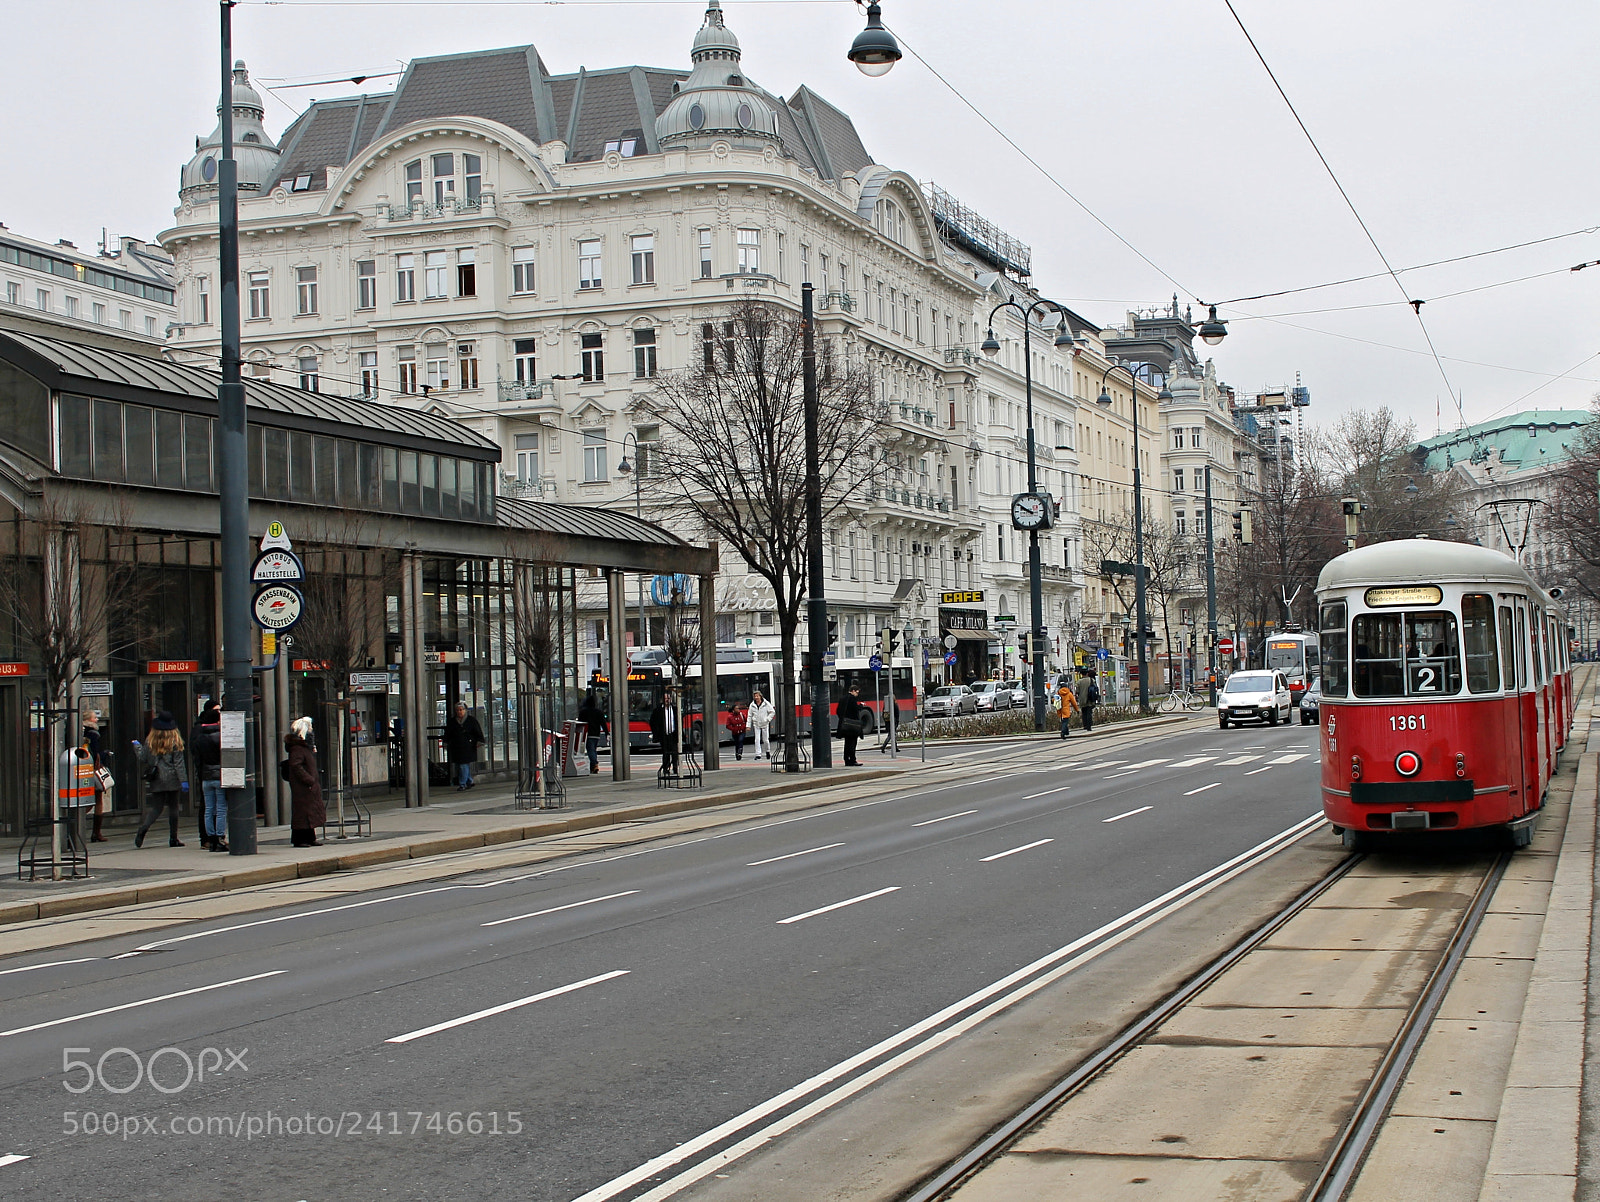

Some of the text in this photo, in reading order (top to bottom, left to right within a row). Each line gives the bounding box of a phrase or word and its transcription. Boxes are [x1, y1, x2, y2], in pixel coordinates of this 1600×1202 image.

[271, 524, 279, 535] H
[263, 553, 291, 565] AUTOBUS
[257, 570, 297, 578] HALTESTELLE
[258, 589, 297, 607] STRASSENBAHN
[943, 591, 982, 603] CAFE
[1368, 588, 1400, 596] Ottakringer
[261, 611, 296, 627] HALTESTELLE
[950, 616, 984, 629] CAFE MILANO
[285, 637, 292, 646] 2
[2, 664, 12, 674] U3
[164, 662, 185, 671] Linie U3
[1417, 667, 1436, 691] 2
[1389, 714, 1427, 731] 1361
